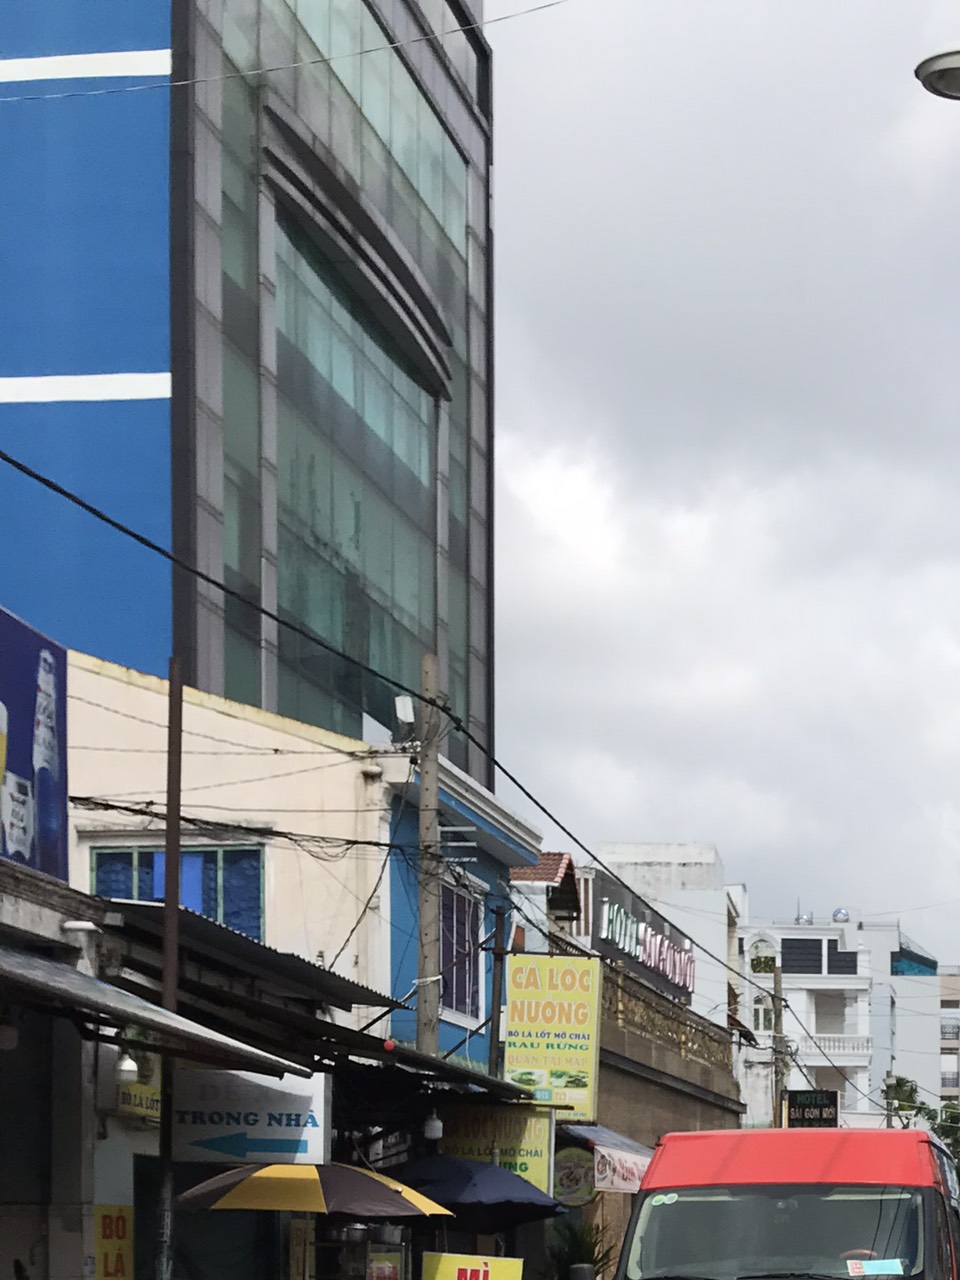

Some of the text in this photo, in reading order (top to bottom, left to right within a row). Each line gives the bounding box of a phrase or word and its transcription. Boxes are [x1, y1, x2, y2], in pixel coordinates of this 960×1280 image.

[511, 961, 592, 993] CÁ LÓC
[510, 996, 589, 1025] NƯỚNG
[508, 1041, 540, 1049] RAU
[174, 1110, 319, 1128] TRONG NHÀ
[102, 1208, 127, 1239] BÒ
